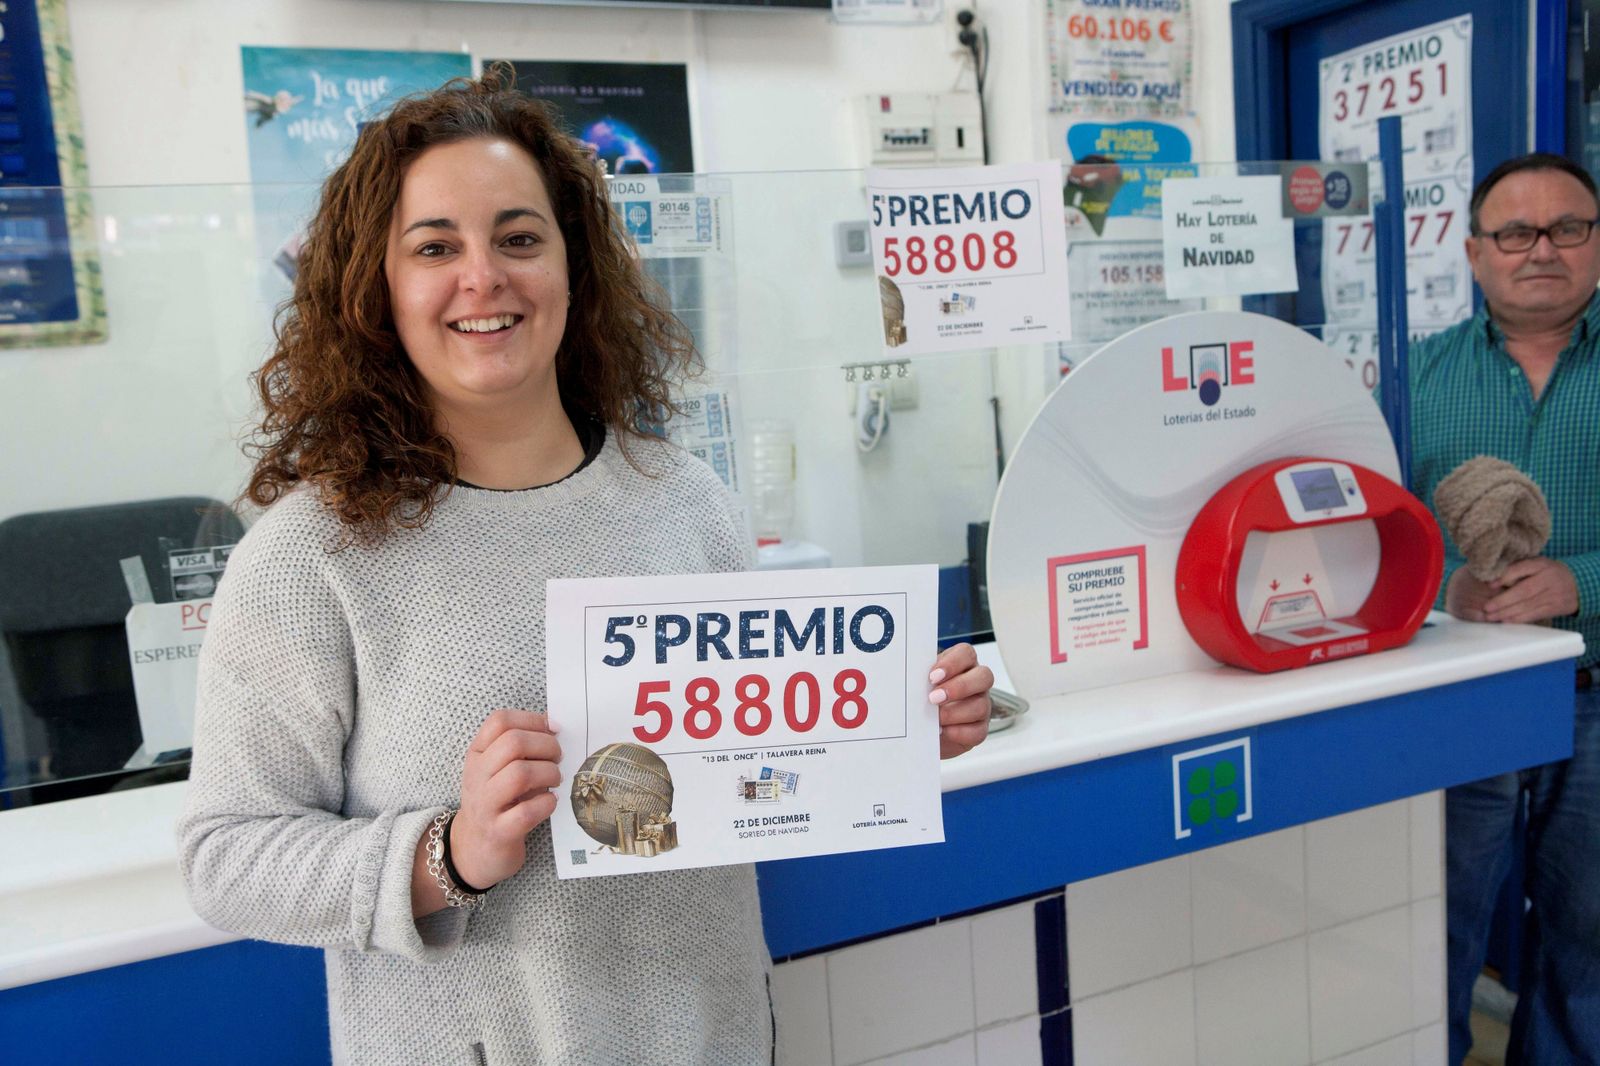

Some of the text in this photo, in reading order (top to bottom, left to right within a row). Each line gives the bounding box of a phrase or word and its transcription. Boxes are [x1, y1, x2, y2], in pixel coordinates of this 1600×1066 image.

[1068, 14, 1175, 43] 60.106 €
[1363, 36, 1442, 77] PREMIO
[1062, 79, 1137, 97] VENDIDO
[1334, 62, 1447, 122] 37251
[658, 202, 691, 212] 90146
[889, 188, 1031, 227] PREMIO
[883, 229, 1018, 277] 58808
[1182, 247, 1255, 267] NAVIDAD
[1206, 408, 1221, 422] del
[1224, 405, 1256, 420] Estado
[176, 554, 207, 567] VISA
[1067, 565, 1125, 582] COMPRUEBE
[1068, 575, 1126, 593] SU PREMIO
[181, 602, 212, 625] PO
[655, 604, 895, 665] PREMIO
[134, 643, 202, 664] ESPERE
[632, 668, 869, 744] 58808
[716, 754, 730, 762] DEL
[766, 749, 804, 759] TALAVERA
[805, 747, 827, 756] REINA
[733, 813, 811, 829] 22 DE DICIEMBRE
[852, 818, 908, 829] LOTERÍA NACIONAL
[738, 825, 809, 839] SORTEO DE NAVIDAD
